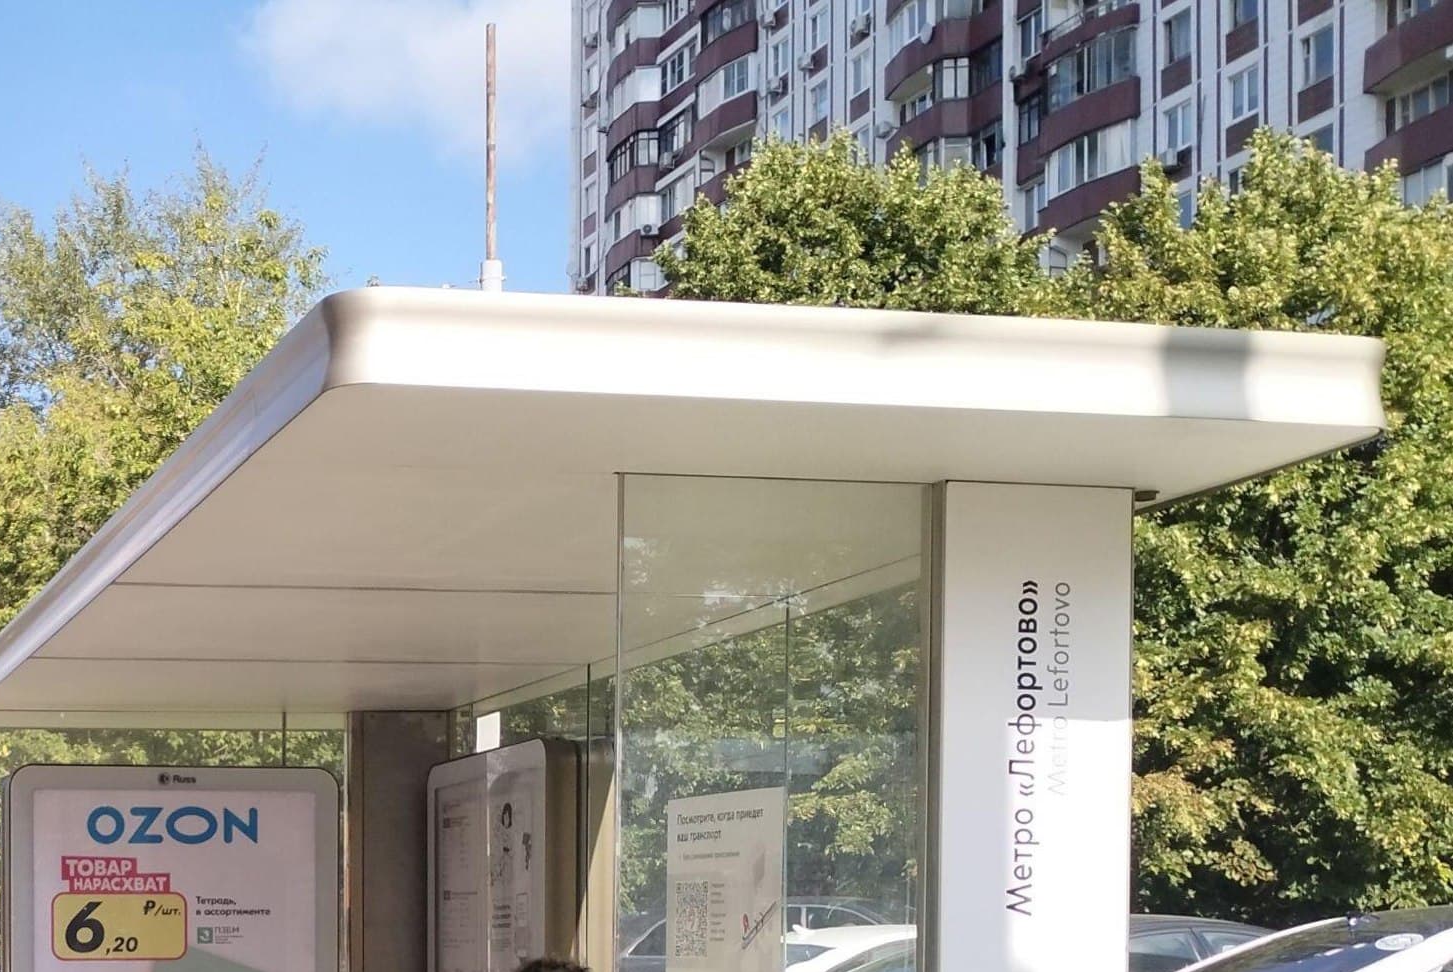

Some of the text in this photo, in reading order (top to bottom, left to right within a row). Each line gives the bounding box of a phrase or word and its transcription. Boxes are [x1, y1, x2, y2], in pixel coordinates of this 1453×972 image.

[1047, 582, 1071, 706] Lefortovo
[87, 806, 259, 845] OZON
[65, 859, 133, 877] ТОВАР
[1005, 808, 1040, 916] Метро
[73, 876, 167, 892] НАРАСХВАТ
